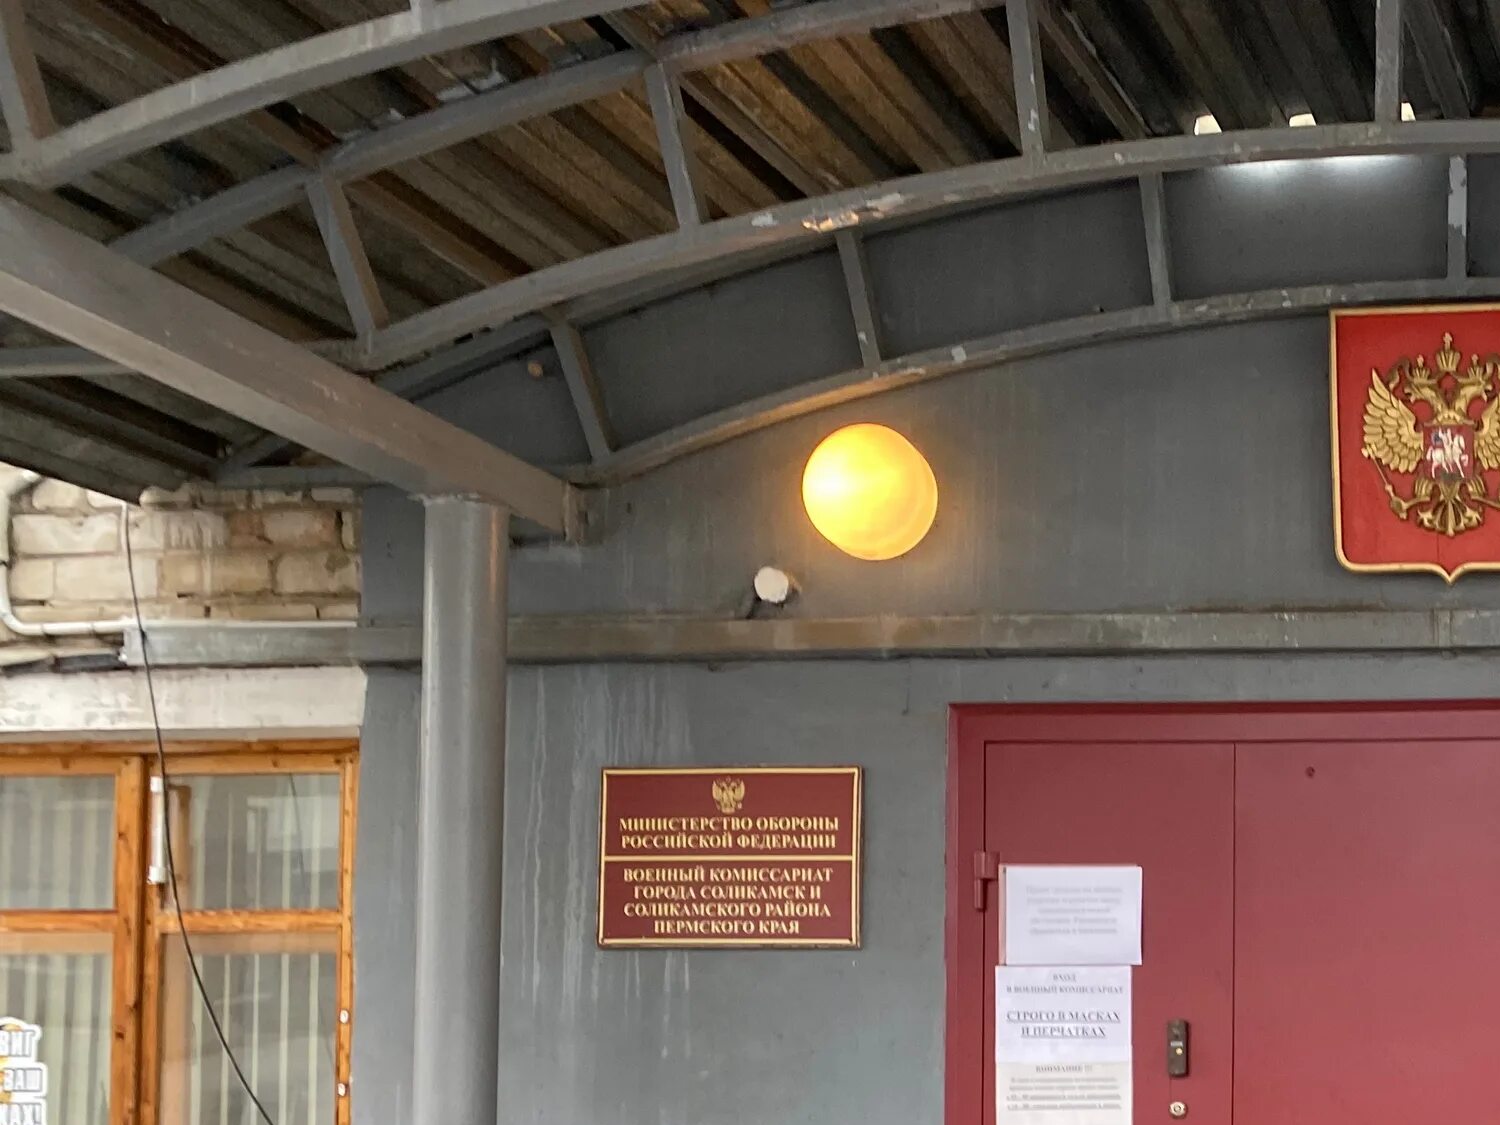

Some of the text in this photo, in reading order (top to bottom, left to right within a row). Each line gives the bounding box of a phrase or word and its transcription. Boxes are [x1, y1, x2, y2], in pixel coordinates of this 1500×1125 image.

[620, 816, 839, 831] МИНИСТЕРСТВО ОБОРОНЫ
[621, 831, 836, 851] РОССИЙСКОЙ ФЕДЕРАЦИИ
[623, 865, 833, 882] ВОЕННЫЙ КОМИССАРИАТ
[634, 885, 821, 900] ГОРОДА СОЛИКАМСК И
[623, 900, 832, 917] СОЛИКАМСКОГО РАЙОНА
[654, 919, 800, 934] ПЕРМСКОГО КРАЯ
[1006, 1010, 1121, 1022] СТРОГО В МАСКАХ
[1021, 1025, 1106, 1037] И ПЕРЧАТКАХ
